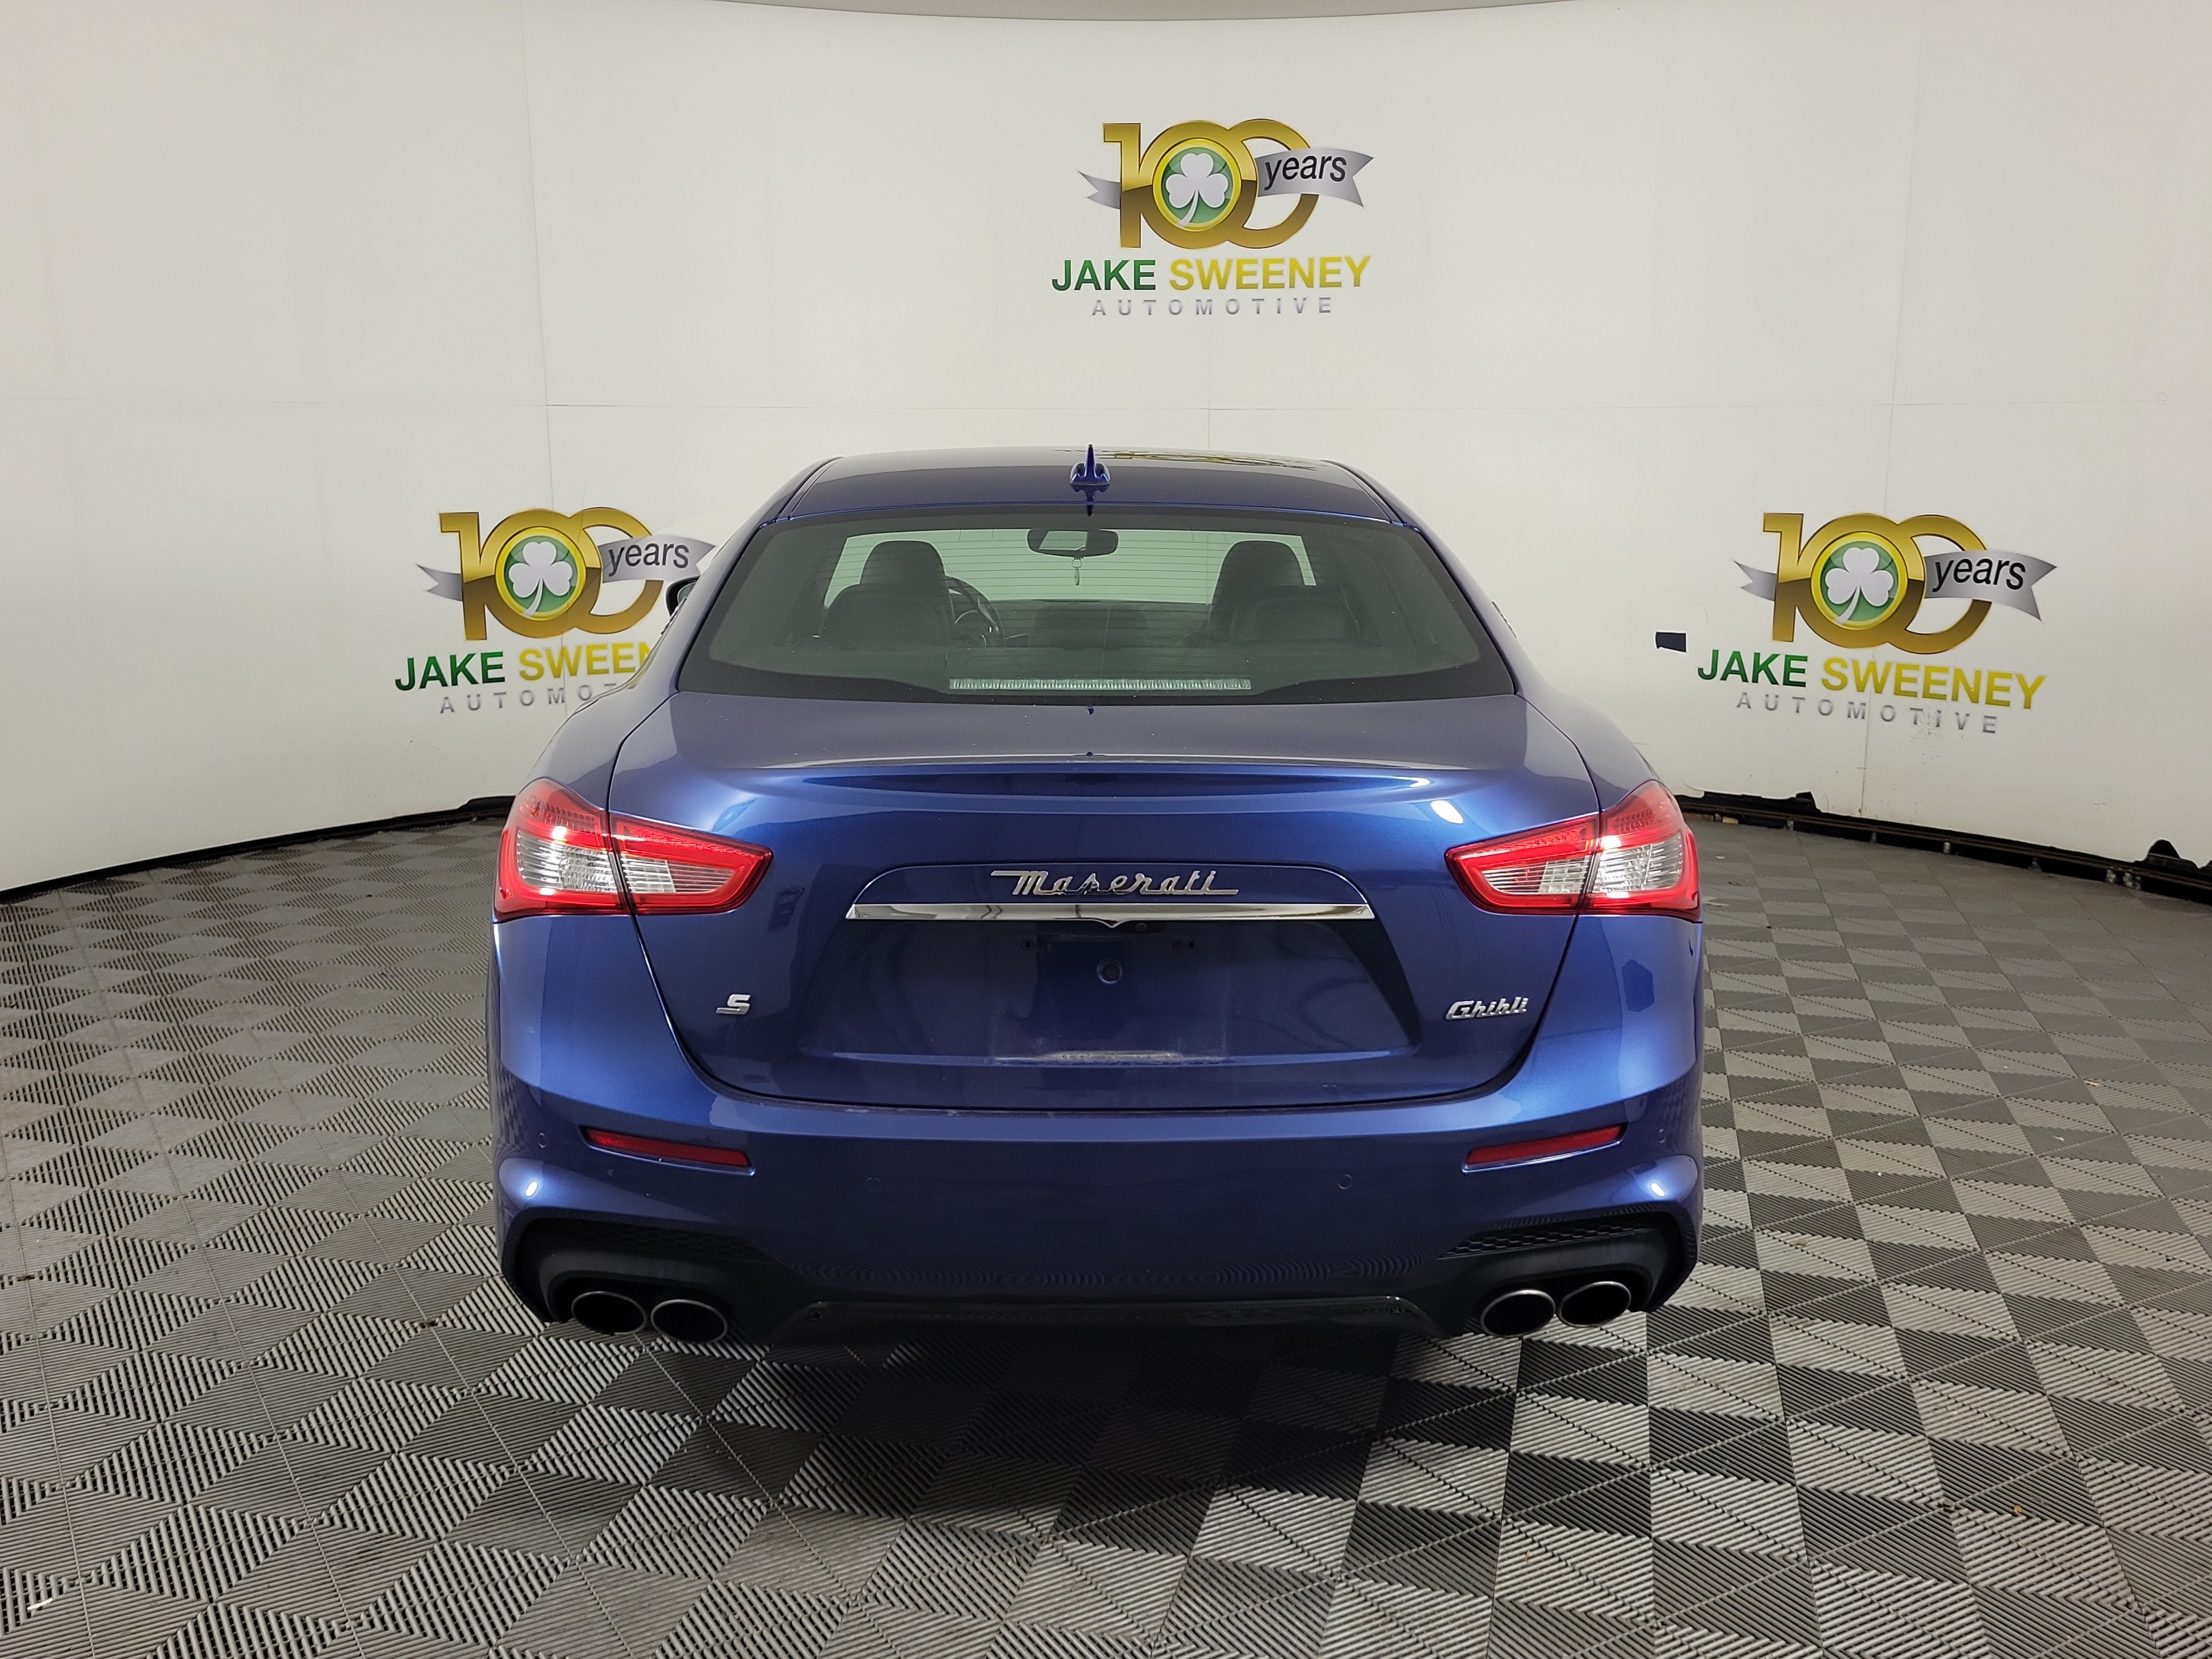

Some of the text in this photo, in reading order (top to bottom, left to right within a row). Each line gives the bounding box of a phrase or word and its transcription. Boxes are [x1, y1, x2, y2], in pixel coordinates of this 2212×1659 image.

[1264, 154, 1347, 190] years
[1052, 256, 1372, 291] JAKE SWEENEY
[1092, 297, 1332, 316] AUTOMOTIVE
[608, 541, 690, 577] years
[1932, 557, 2026, 592] years
[395, 651, 506, 691] JAKE
[1697, 649, 2046, 709] JAKE SWEENEY
[1736, 692, 1997, 733] AUTOMOTIVE
[990, 870, 1239, 895] Maserati
[716, 994, 751, 1015] S
[1446, 996, 1528, 1020] Ghibli
